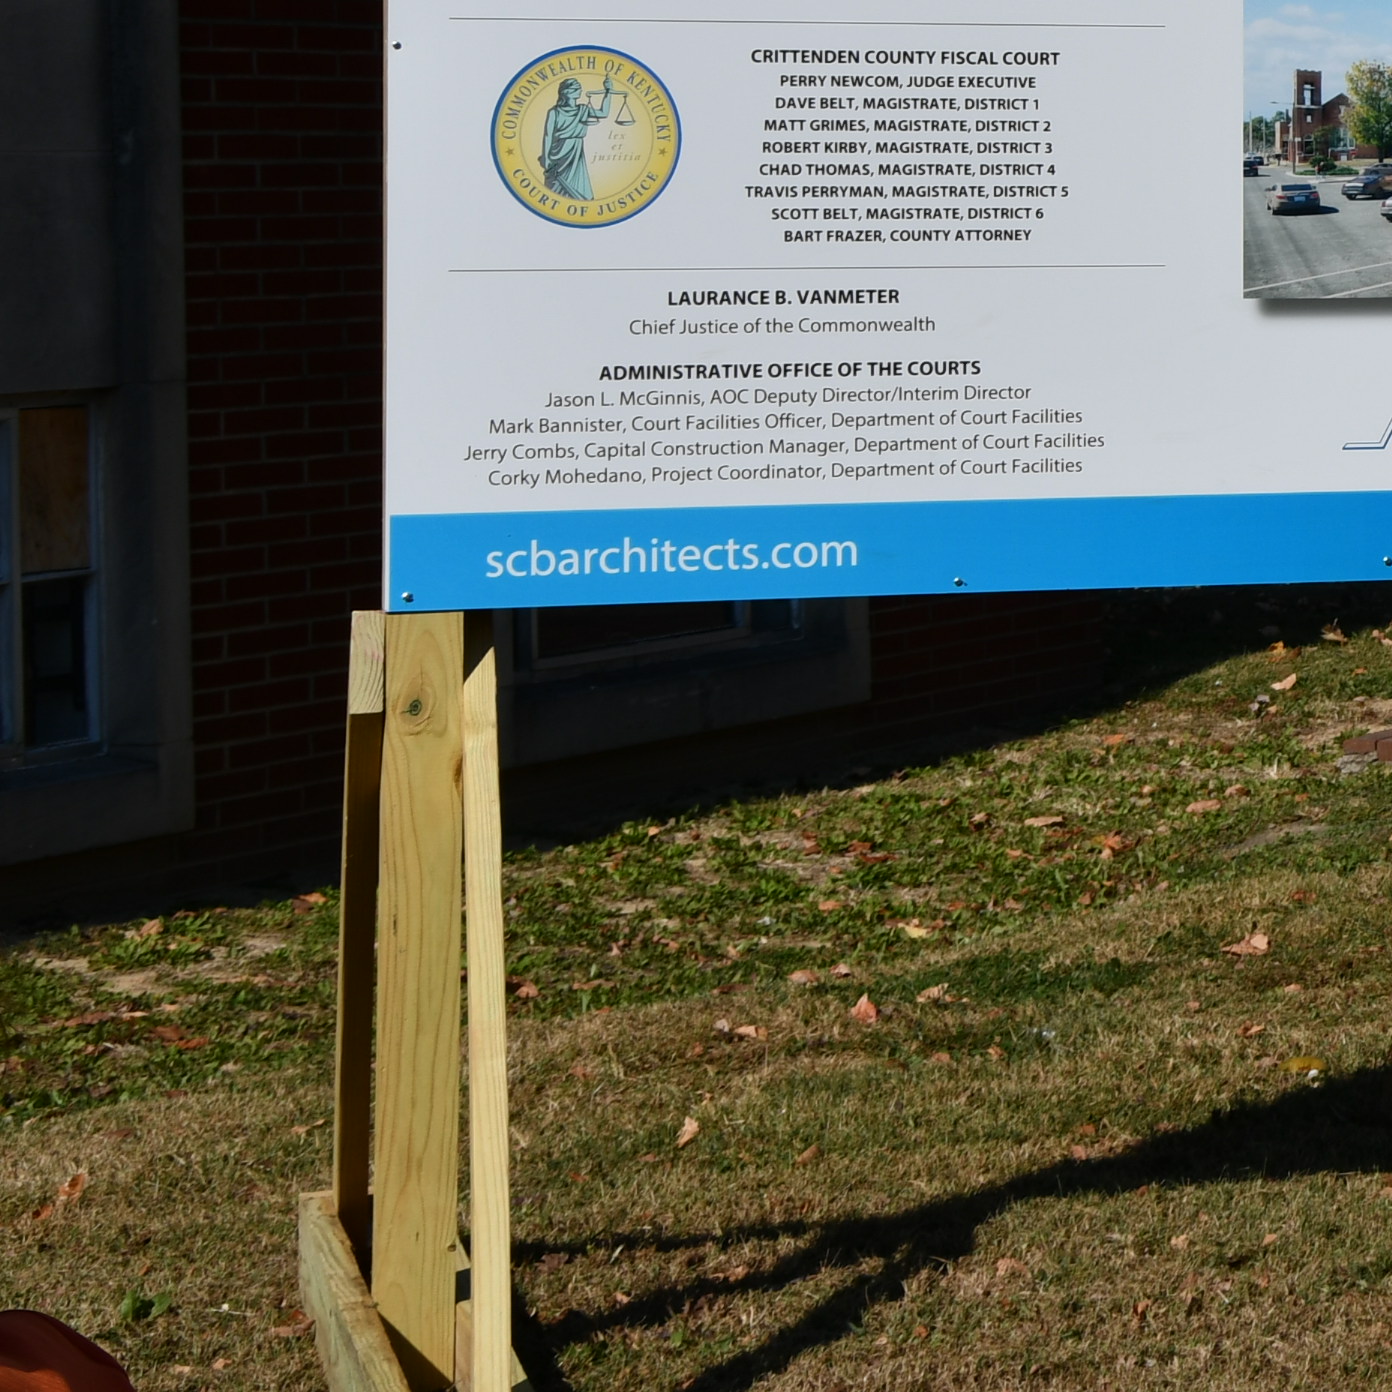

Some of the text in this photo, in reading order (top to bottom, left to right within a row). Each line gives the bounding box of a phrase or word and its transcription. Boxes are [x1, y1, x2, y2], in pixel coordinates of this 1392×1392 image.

[750, 48, 1061, 66] CRITTENDEN COUNTY FISCAL COURT
[779, 74, 1036, 89] PERRY NEWCOM, JUDGE EXECUTIVE
[502, 56, 671, 143] COMMONWEALTH OF KENTUCKY
[775, 96, 1039, 112] DAVE BELT, MAGISTRATE, DISTRICT 1
[758, 163, 1056, 177] CHAD THOMAS, MAGISTRATE, DISTRICT 4
[512, 168, 659, 217] COURT OF JUSTICE
[744, 185, 1069, 199] TRAVIS PERRYMAN, MAGISTRATE, DISTRICT 5
[667, 288, 899, 306] LAURANCE B. VANMETER
[629, 315, 935, 335] Chief Justice of the Commonwealth
[598, 359, 981, 381] ADMINISTRATIVE OFFICE OF THE COURTS
[544, 384, 1032, 408] Jason L. McGinnis, AOC Deputy Director/Interim Director
[488, 407, 1083, 434] Mark Bannister, Court Facilities Officer, Department of Court Facilities
[463, 432, 1105, 464] Jerry Combs, Capital Construction Manager, Department of Court Facilities
[487, 457, 1083, 489] Corky Mohedano, Project Coordinator, Department of Court Facilities
[485, 536, 857, 578] scbarchitects.com
